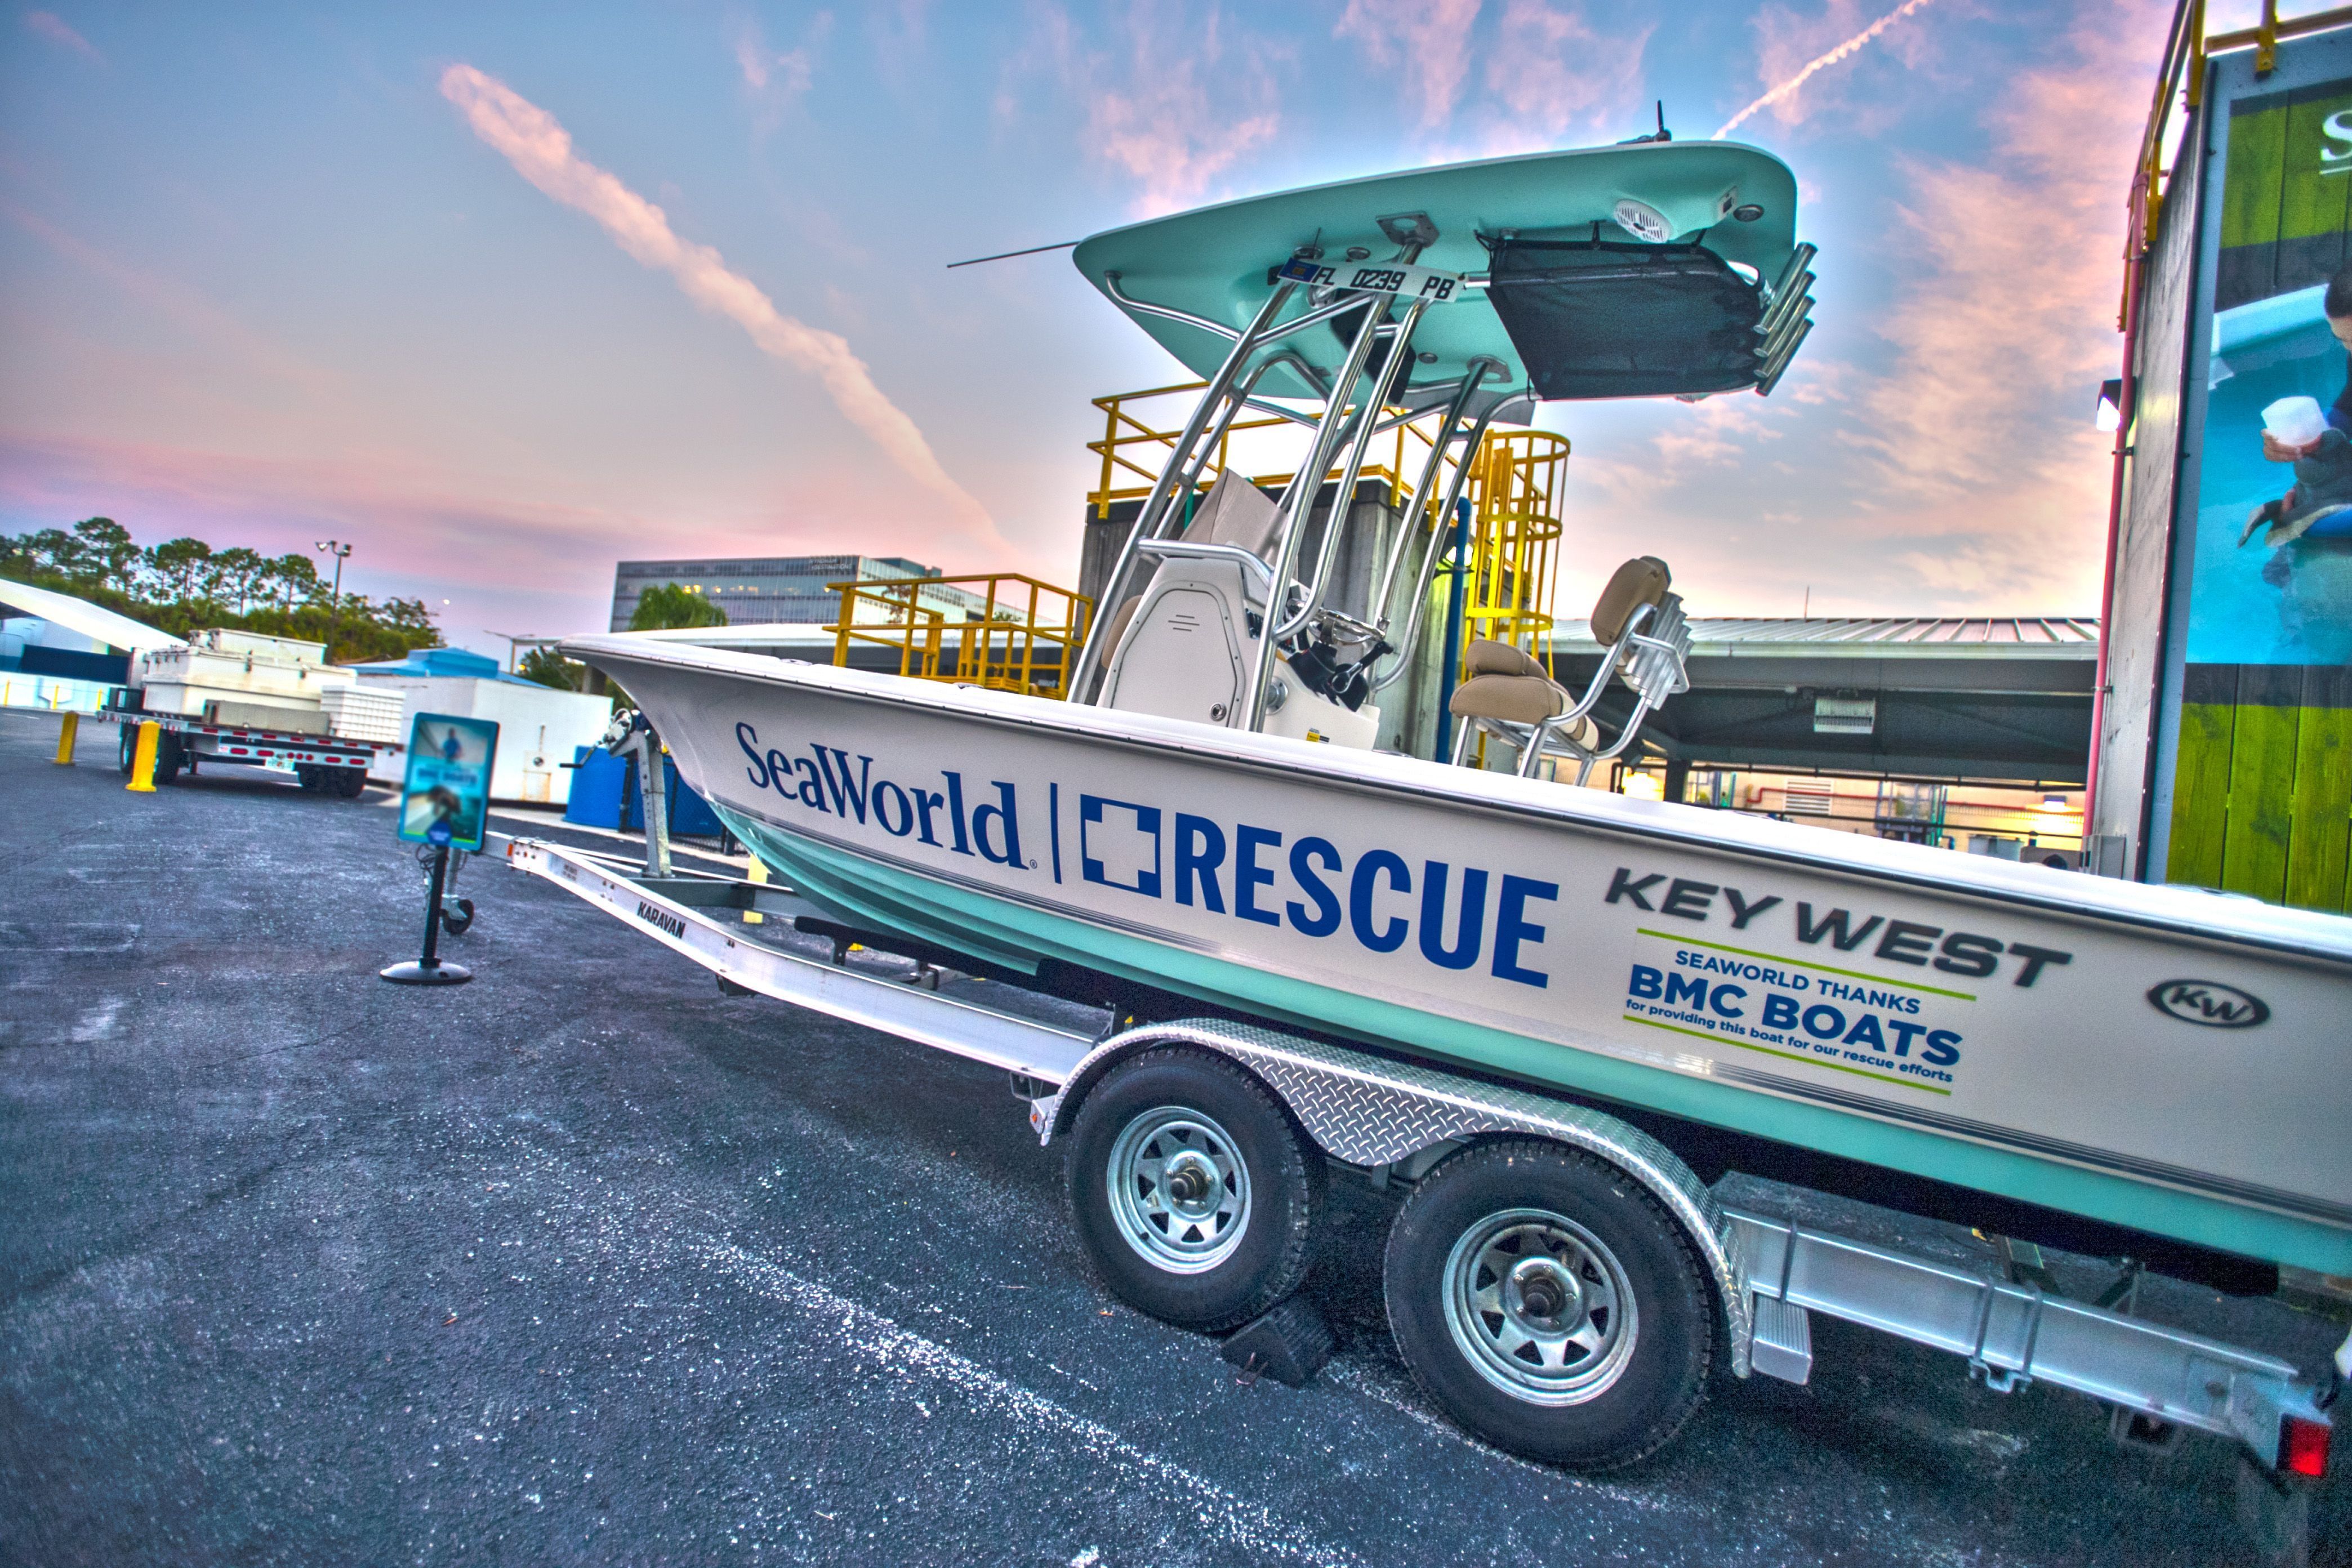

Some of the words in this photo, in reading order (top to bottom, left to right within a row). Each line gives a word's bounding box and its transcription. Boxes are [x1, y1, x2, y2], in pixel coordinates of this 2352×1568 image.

[1312, 267, 1337, 286] FL
[1349, 269, 1406, 292] 0239
[1419, 276, 1455, 299] PB
[637, 902, 685, 939] KARAVAN
[1175, 812, 1559, 988] RESCUE
[1605, 867, 1784, 929] KEY
[1797, 901, 2073, 988] WEST
[1629, 964, 1748, 1018] BMC
[1762, 993, 1963, 1066] BOATS
[1675, 950, 1809, 990] SEAWORLD
[1818, 979, 1921, 1014] THANKS
[2170, 987, 2251, 1021] KW
[1626, 999, 1645, 1012] for
[1649, 1006, 1716, 1030] providing
[1720, 1021, 1745, 1035] this
[1750, 1027, 1784, 1044] boat
[1788, 1036, 1810, 1050] for
[1814, 1044, 1839, 1057] our
[1843, 1051, 1894, 1069] rescue
[1899, 1063, 1953, 1083] efforts
